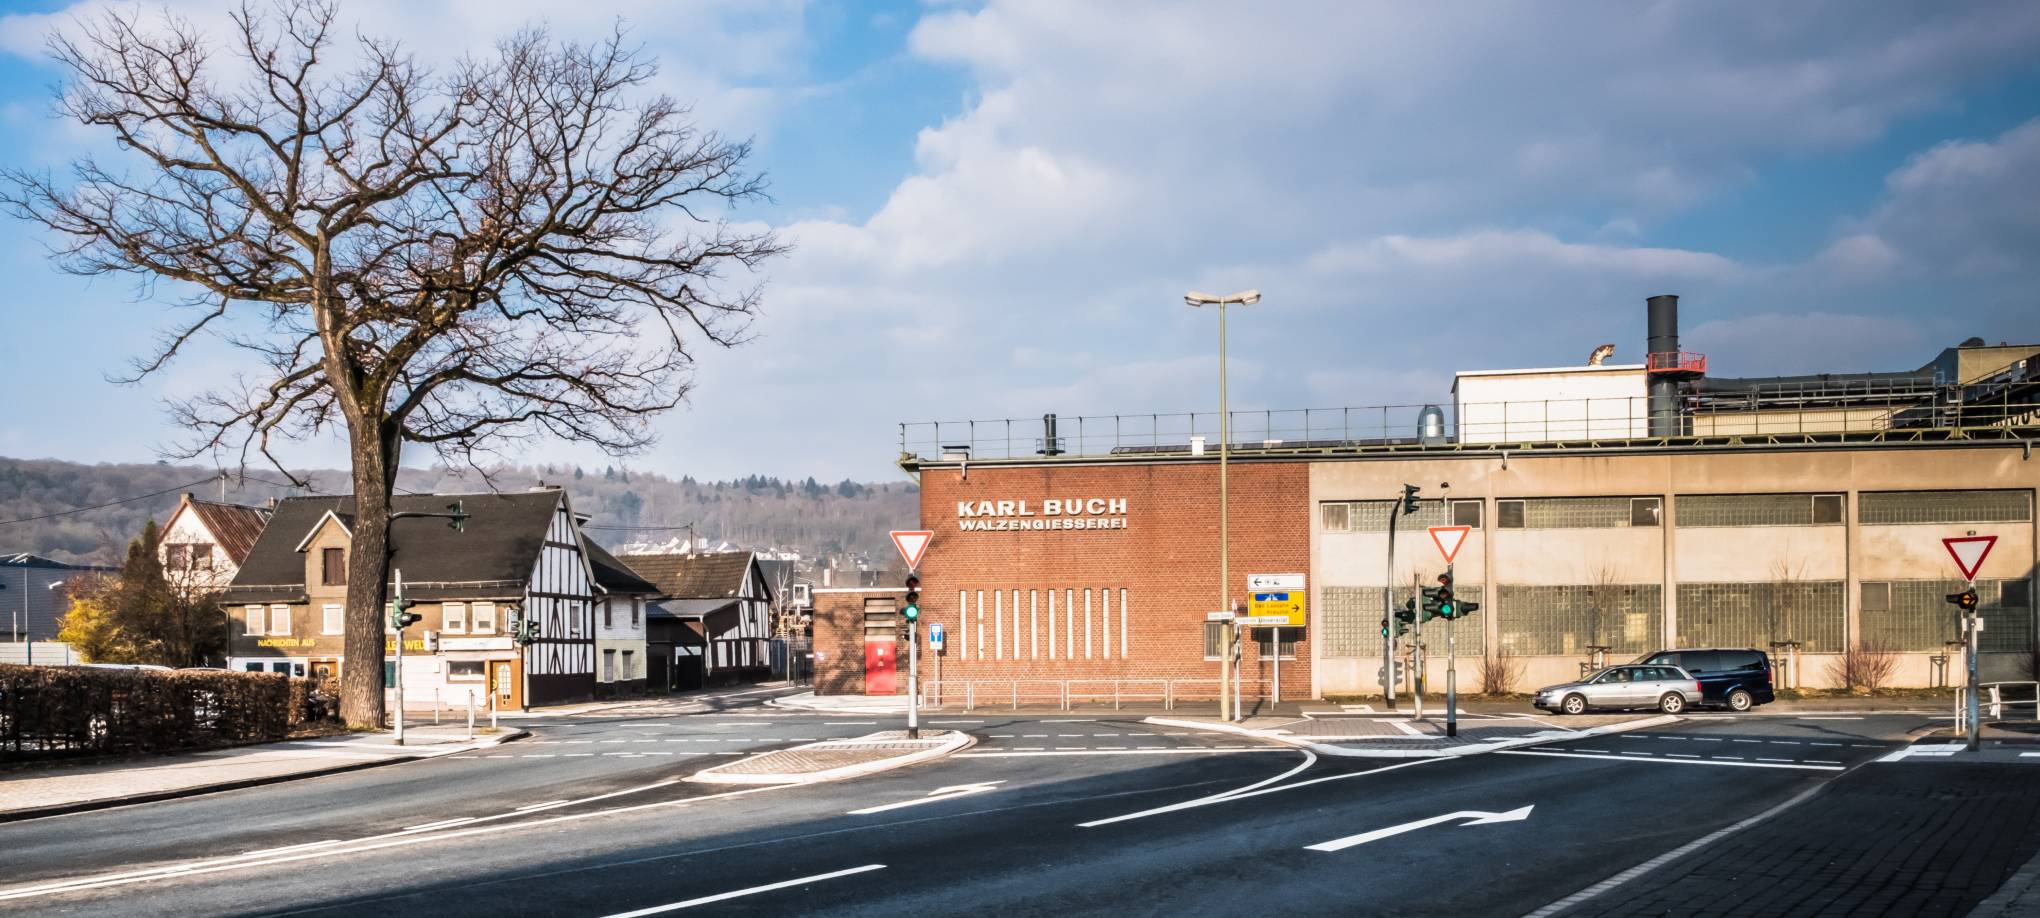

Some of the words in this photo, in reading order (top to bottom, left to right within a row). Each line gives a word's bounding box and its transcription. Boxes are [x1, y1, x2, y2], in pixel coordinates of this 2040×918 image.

[957, 500, 1035, 517] KARL
[1043, 498, 1127, 516] BUCH
[959, 518, 1127, 531] WALZENGIESSEREI
[302, 638, 315, 647] AUS
